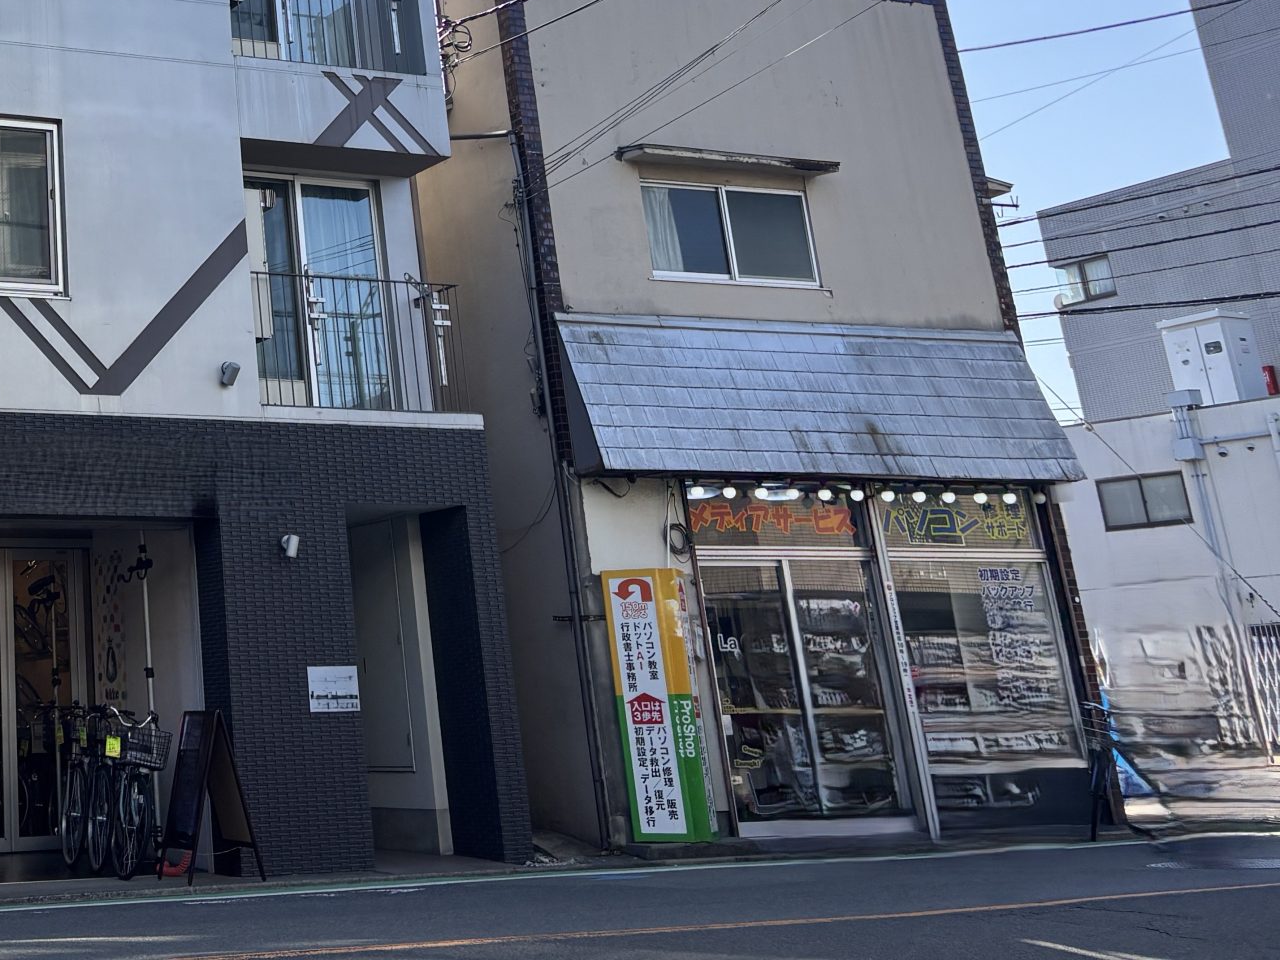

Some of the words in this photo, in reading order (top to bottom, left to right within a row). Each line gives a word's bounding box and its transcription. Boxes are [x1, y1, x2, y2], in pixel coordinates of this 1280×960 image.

[689, 503, 856, 535] メディアサービス
[981, 502, 1023, 520] 修理
[883, 507, 981, 537] パソコン
[984, 520, 1026, 538] サポート
[978, 568, 1021, 581] 初期設定
[982, 585, 1034, 597] バックアップ
[620, 602, 648, 611] 150m
[621, 622, 638, 693] 行政書士事務所
[643, 621, 659, 681] パソコン教室
[632, 701, 660, 711] 入口は
[634, 711, 662, 721] 3歩先
[680, 700, 696, 758] ProShop
